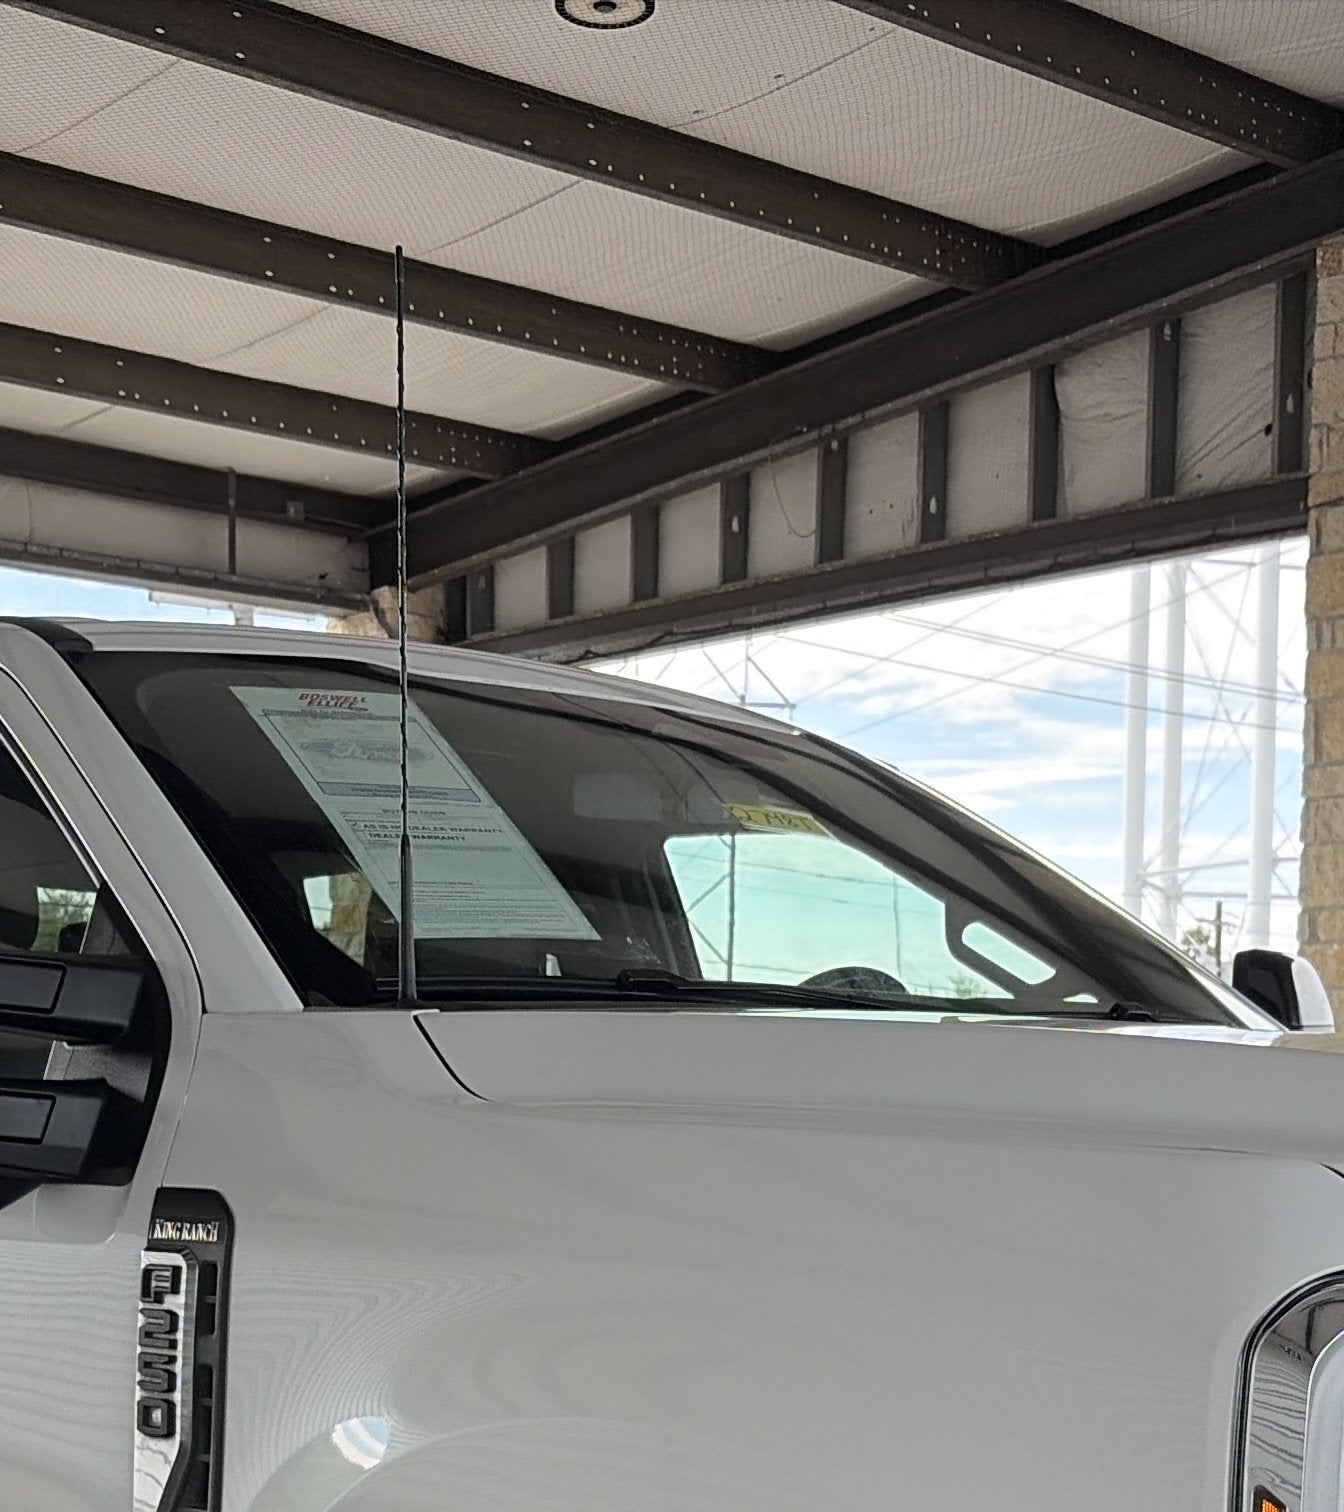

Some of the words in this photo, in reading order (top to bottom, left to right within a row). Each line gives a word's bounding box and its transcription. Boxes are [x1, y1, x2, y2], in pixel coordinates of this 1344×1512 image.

[298, 692, 368, 703] BOSWELL
[153, 1218, 181, 1241] KING
[181, 1220, 220, 1243] RANCH
